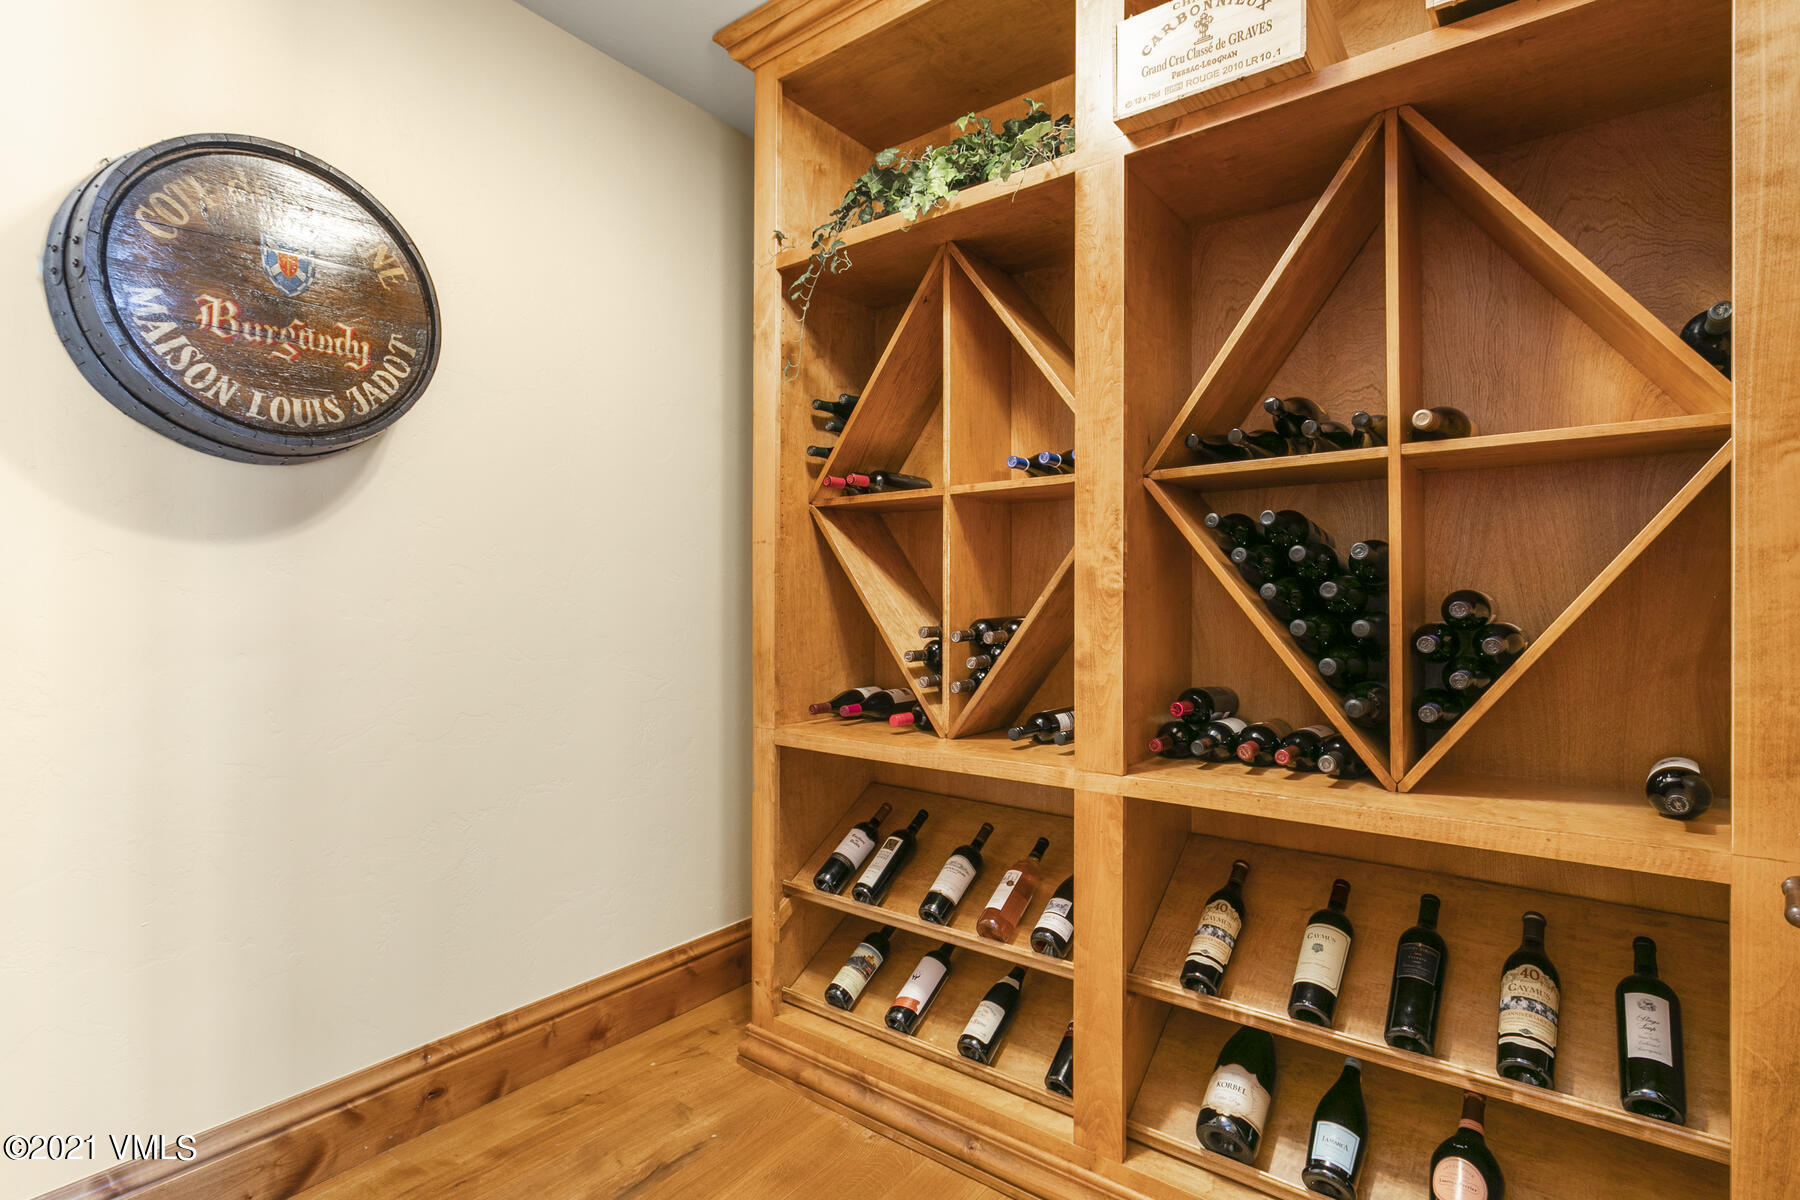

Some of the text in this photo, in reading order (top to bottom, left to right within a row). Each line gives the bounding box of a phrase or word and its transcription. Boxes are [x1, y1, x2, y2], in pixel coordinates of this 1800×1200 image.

[1141, 19, 1273, 78] Grand Cru Classé de GRAVES
[1185, 69, 1220, 88] ROUGE
[1222, 61, 1244, 76] 2010
[122, 284, 417, 428] MAISON LOUIS JADOT
[1214, 903, 1229, 913] 40
[1519, 967, 1540, 981] 40
[1507, 982, 1551, 1001] CAYMUS
[1216, 1081, 1247, 1096] KORBEL
